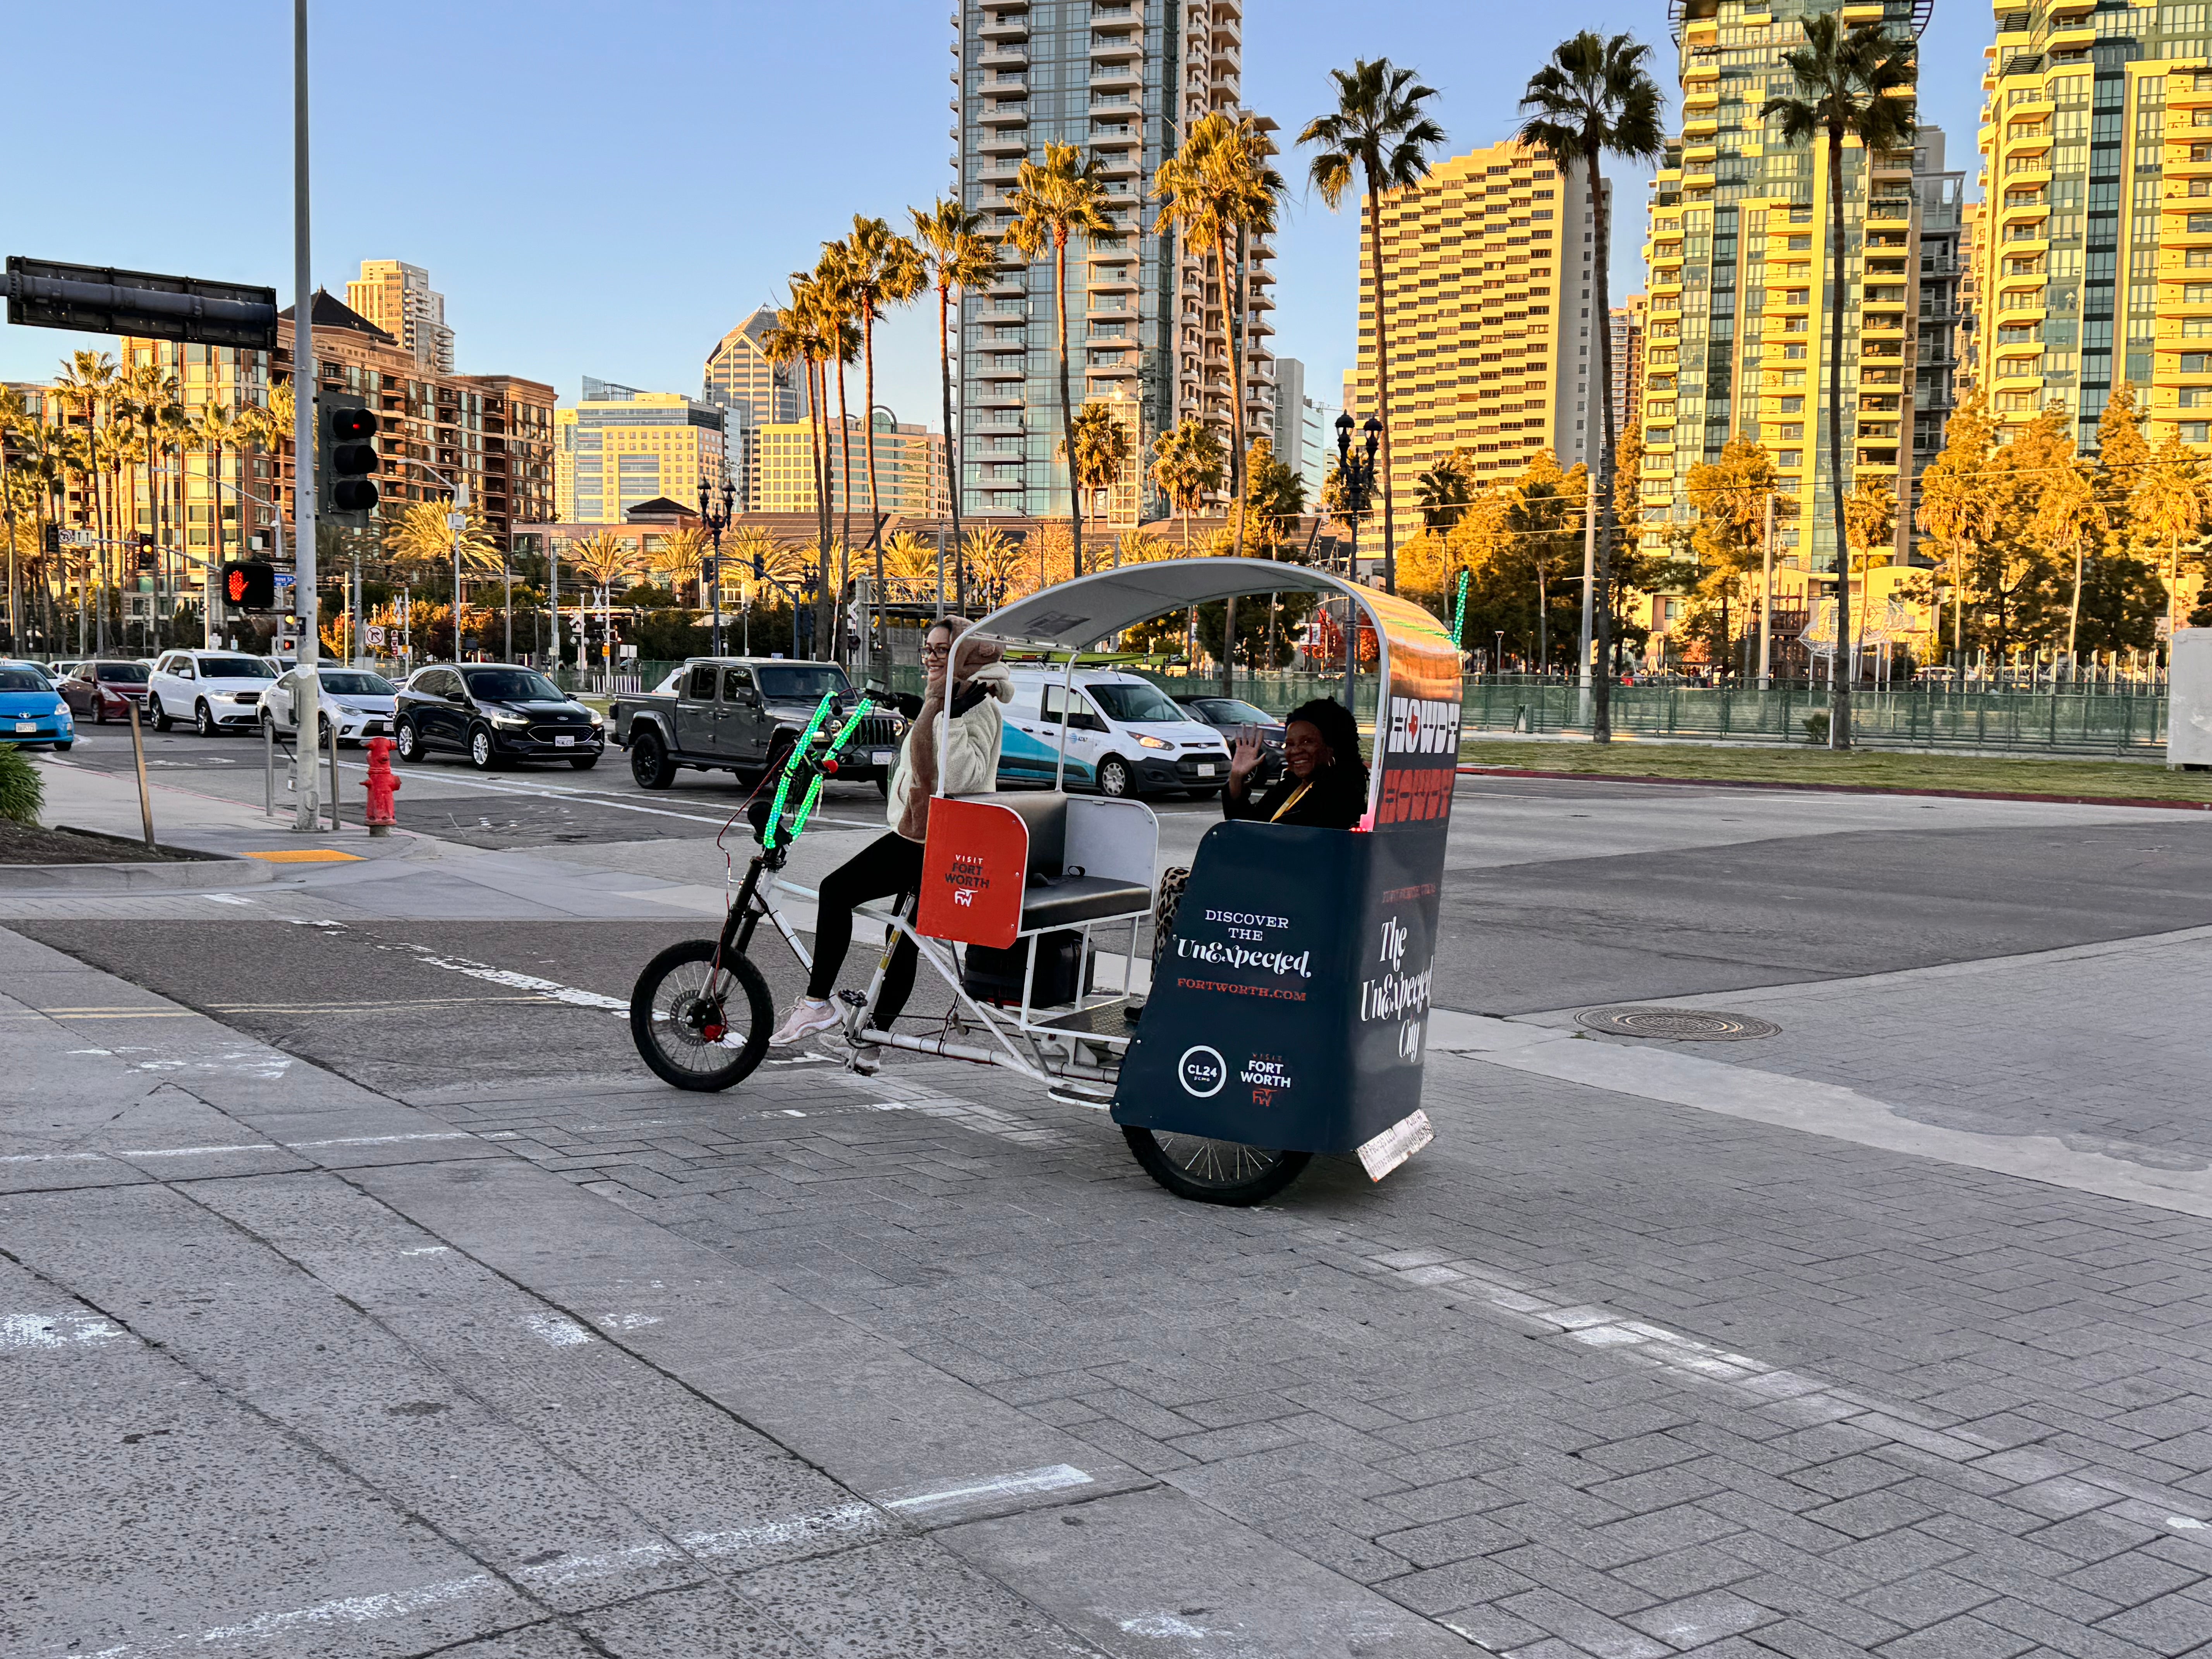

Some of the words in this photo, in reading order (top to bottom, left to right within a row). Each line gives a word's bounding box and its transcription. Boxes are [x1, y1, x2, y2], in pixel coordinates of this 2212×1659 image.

[1388, 696, 1460, 754] HOWDY
[1379, 769, 1455, 824] HOWDY
[955, 854, 983, 864] VISIT
[952, 862, 982, 876] FORT
[945, 873, 990, 888] WORTH
[1205, 910, 1289, 929] DISCOVER
[1228, 927, 1263, 941] THE
[1379, 916, 1407, 972] The
[1177, 978, 1307, 1001] FORTWORTH.COM
[1399, 1018, 1420, 1063] City
[1187, 1064, 1218, 1077] CL24
[1248, 1060, 1284, 1074] FORT
[1240, 1071, 1291, 1088] WORTH
